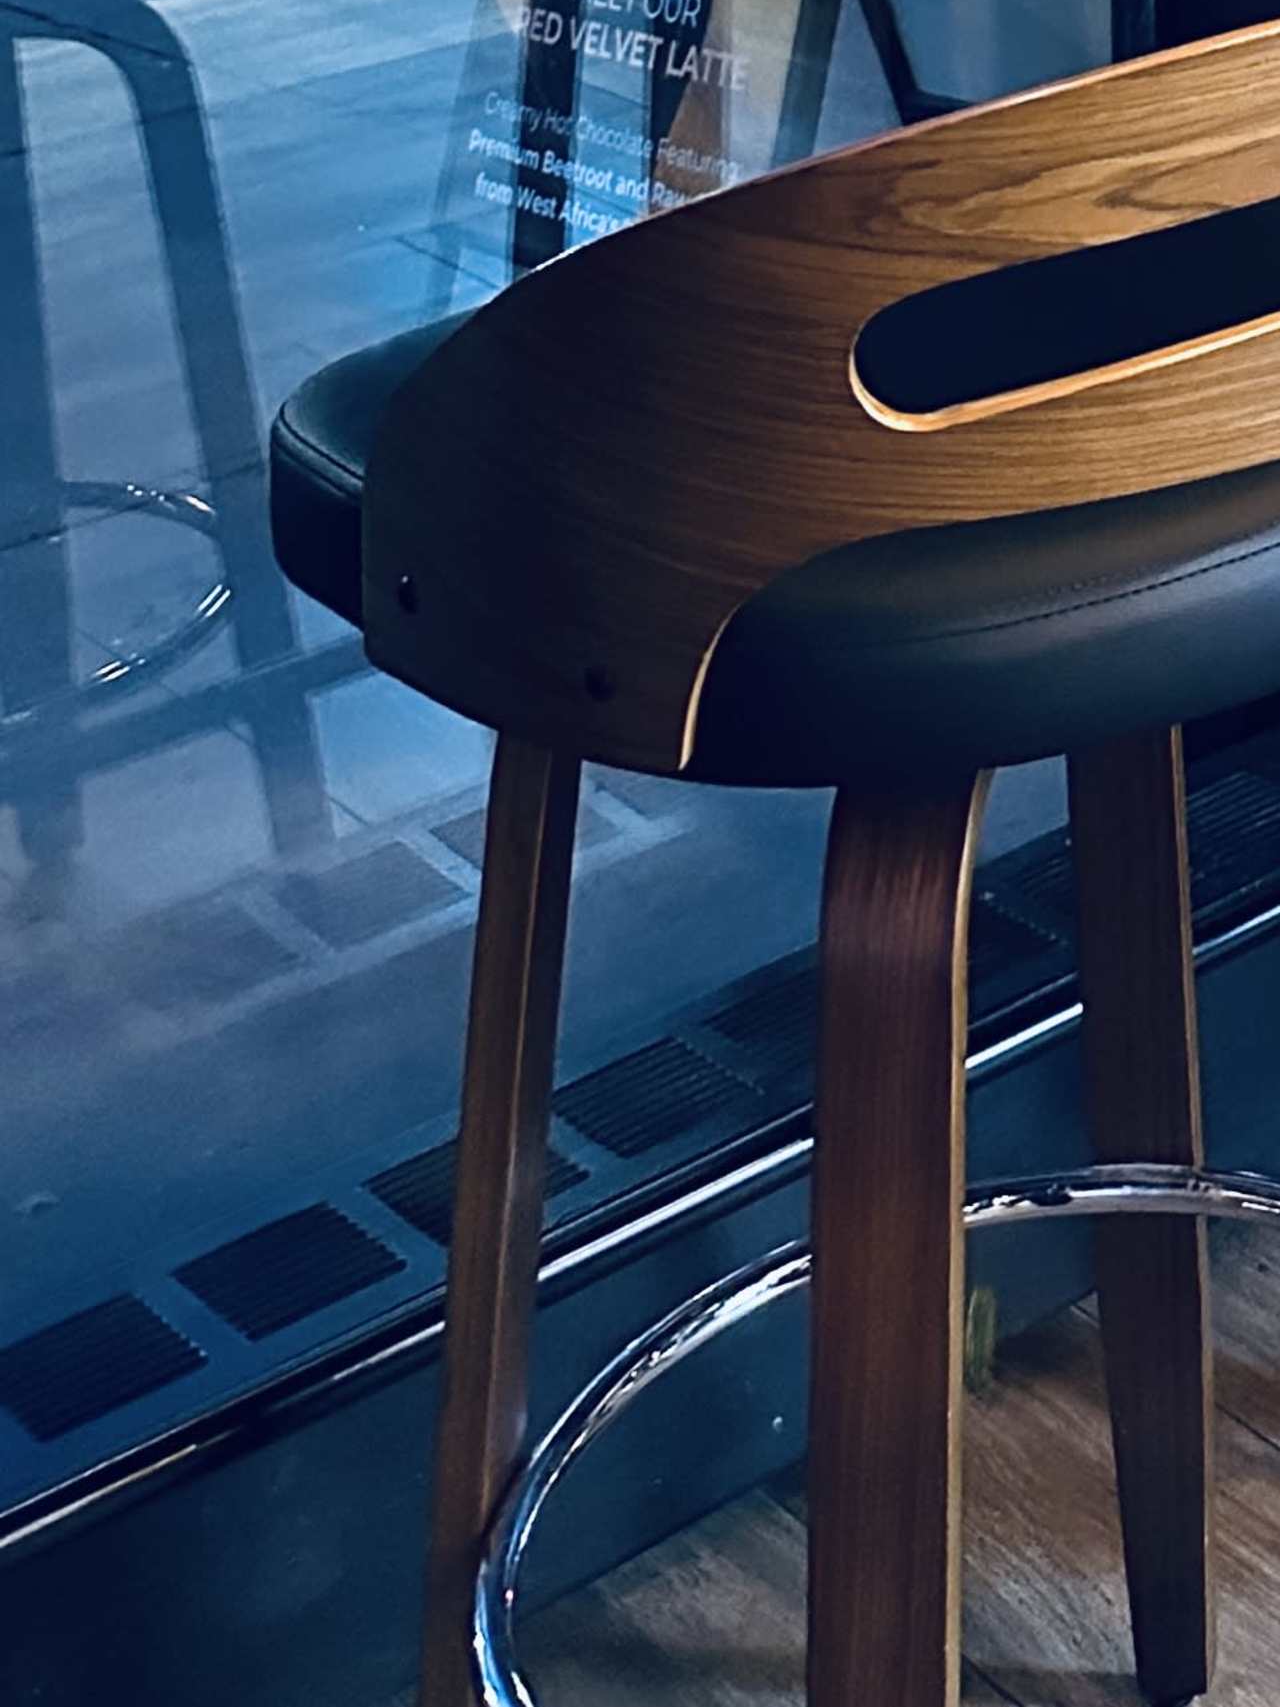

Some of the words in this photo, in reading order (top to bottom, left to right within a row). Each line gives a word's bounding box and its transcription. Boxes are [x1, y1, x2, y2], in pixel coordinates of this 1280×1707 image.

[513, 6, 563, 46] RED
[568, 16, 664, 70] VELVET
[664, 39, 752, 91] LATTE
[484, 90, 541, 133] Creamy
[574, 114, 652, 159] Chocolate
[469, 127, 540, 170] Premium
[541, 149, 613, 192] Beetroot
[615, 173, 649, 202] and
[475, 172, 513, 205] from
[517, 186, 557, 219] West
[559, 201, 624, 233] Africa's
